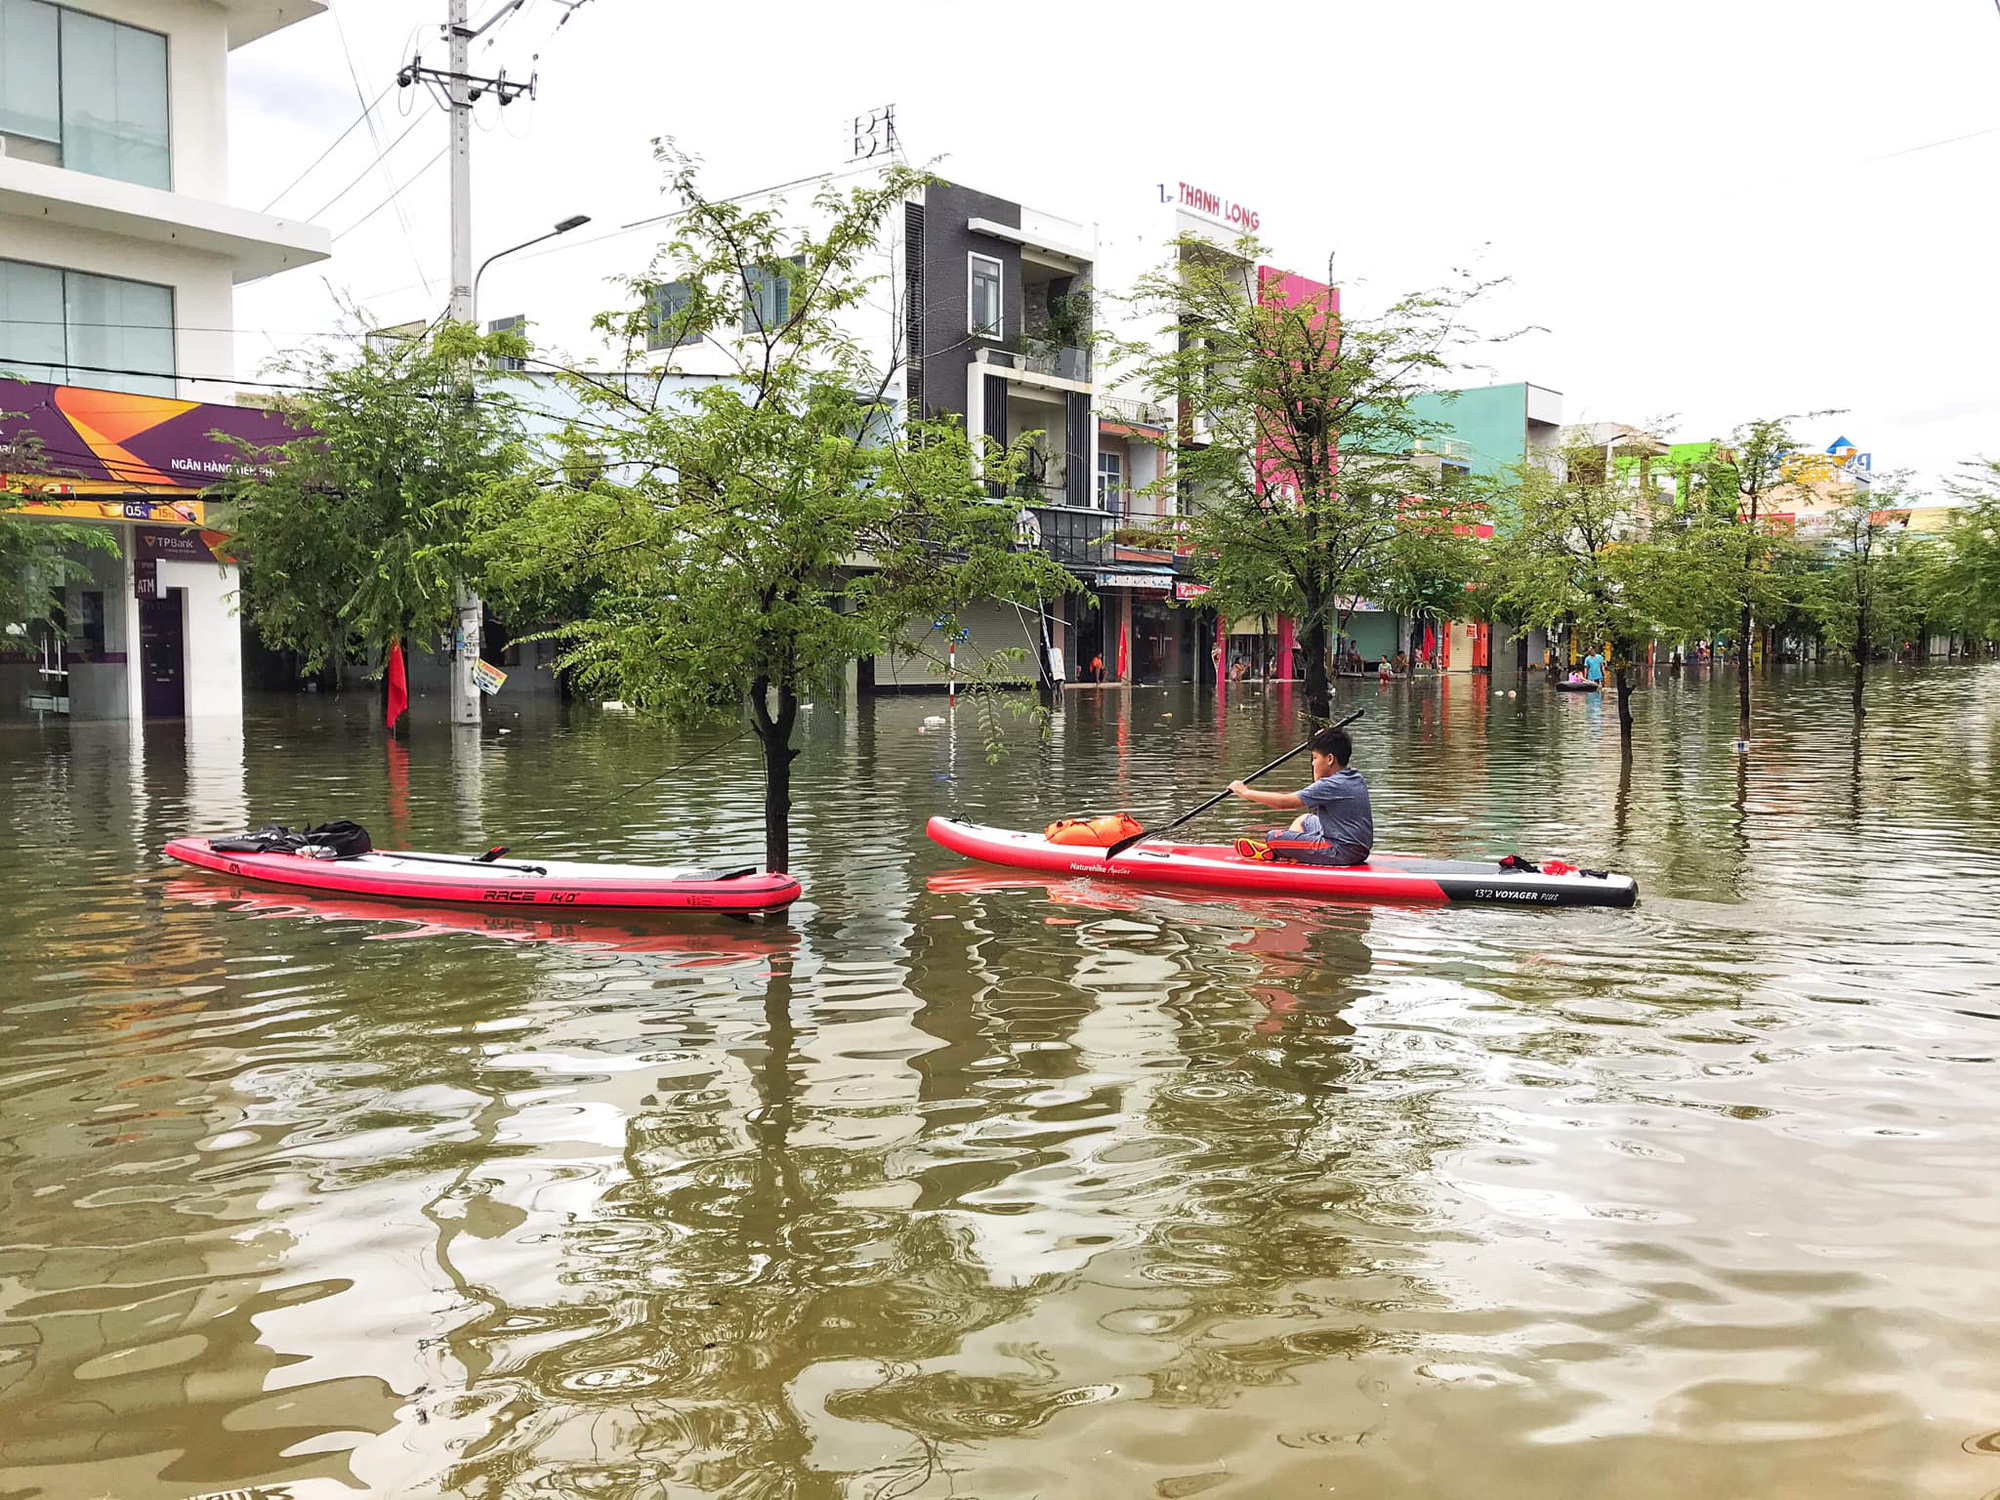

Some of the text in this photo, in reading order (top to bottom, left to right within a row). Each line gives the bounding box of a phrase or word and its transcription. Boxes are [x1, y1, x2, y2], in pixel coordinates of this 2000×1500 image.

[1178, 181, 1220, 217] THANH
[1224, 199, 1260, 231] LONG
[171, 457, 201, 472] NGÂN
[203, 460, 232, 474] HÀNG
[157, 537, 194, 548] TPBank
[137, 578, 155, 593] ATM
[484, 890, 537, 901] RACE
[1495, 890, 1539, 900] VOYAGER
